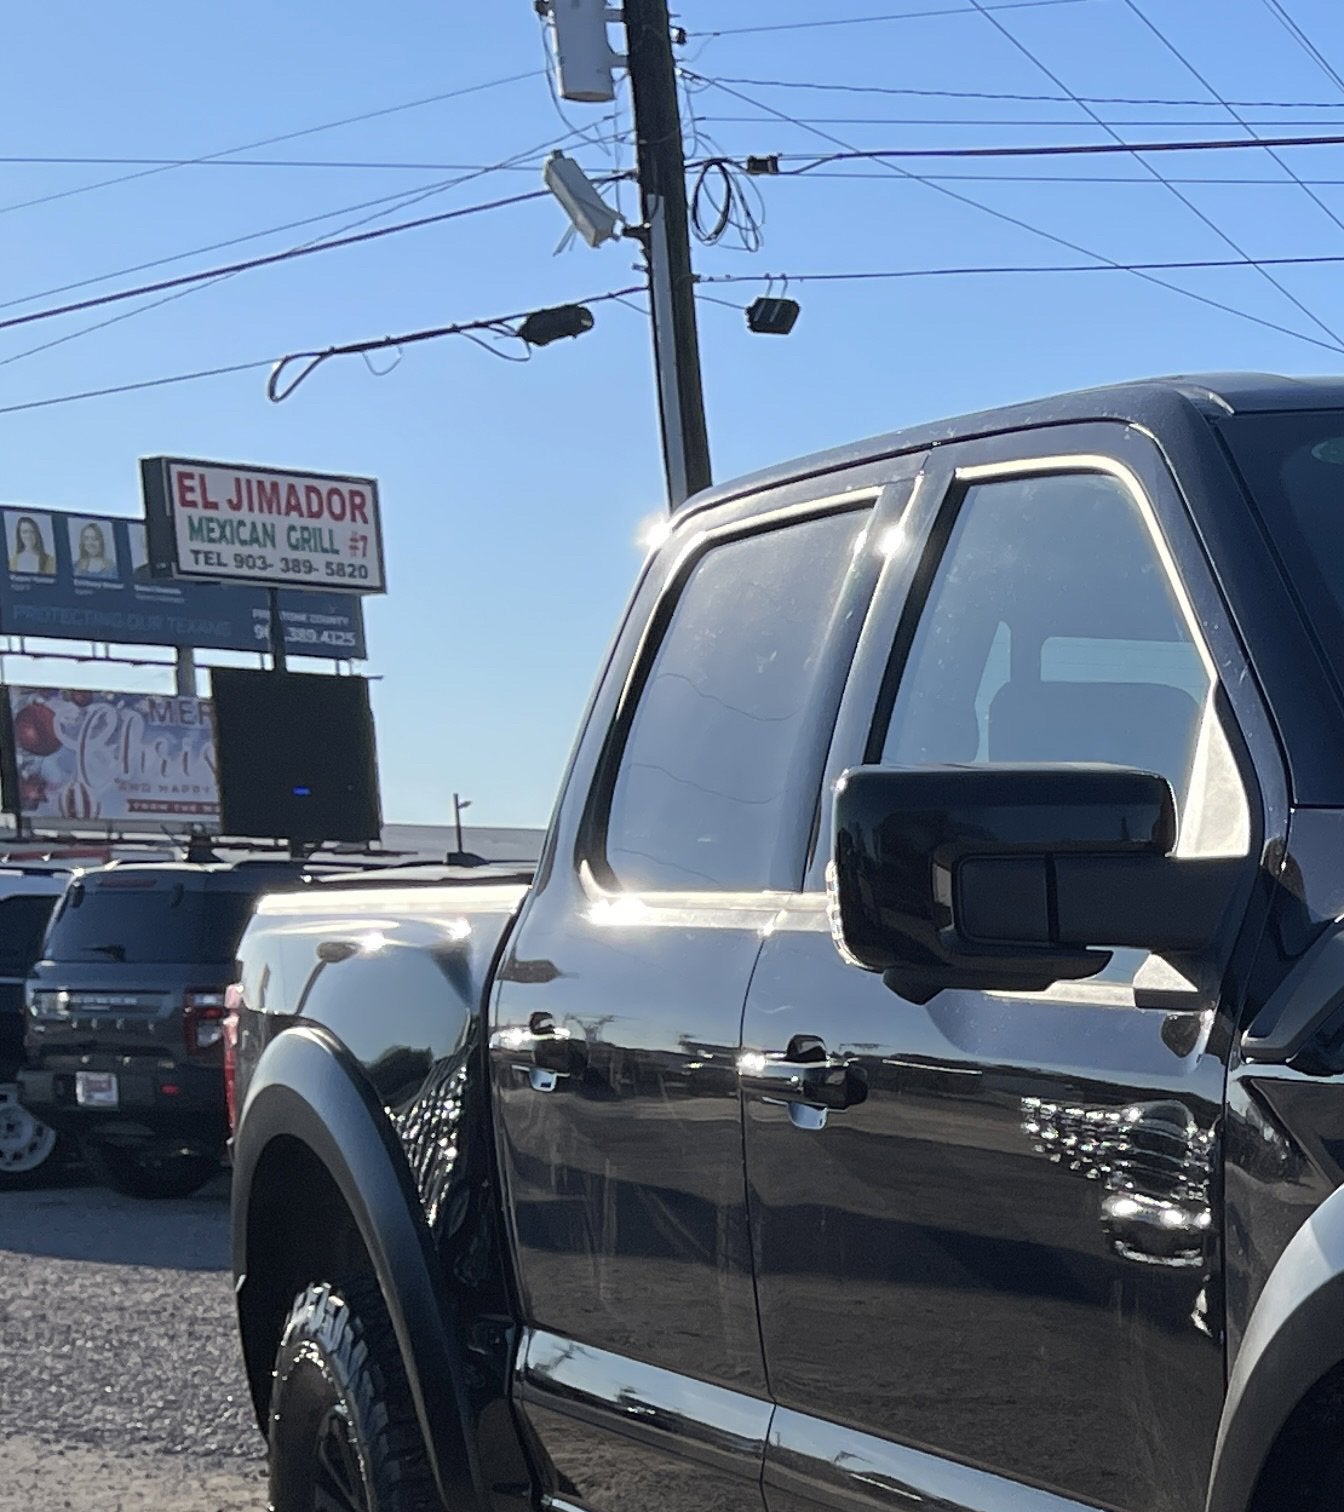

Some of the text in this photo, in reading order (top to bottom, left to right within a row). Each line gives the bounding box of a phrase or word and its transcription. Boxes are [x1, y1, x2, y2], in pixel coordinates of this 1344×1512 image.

[176, 470, 369, 524] EL JIMADOR
[187, 515, 368, 558] MEXICAN GRILL #7
[190, 549, 368, 580] TEL 903- 389- 5820
